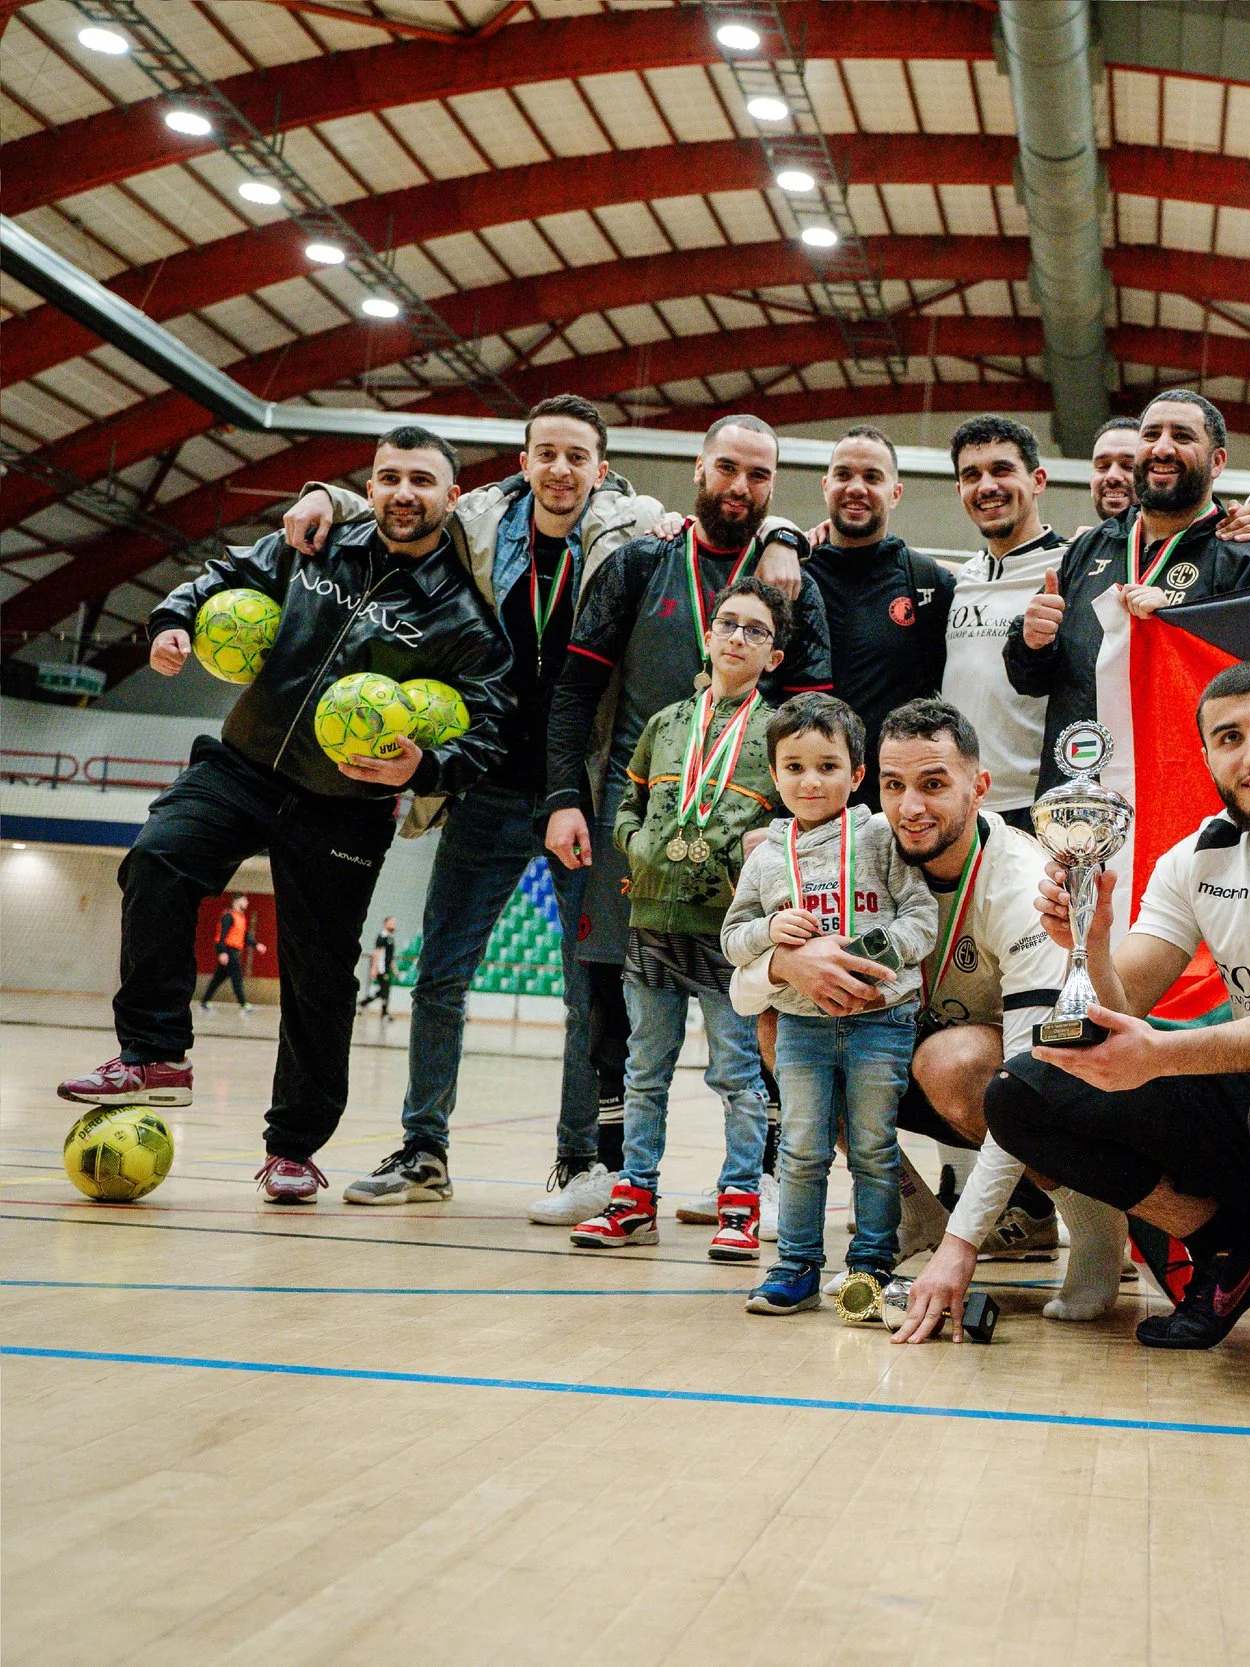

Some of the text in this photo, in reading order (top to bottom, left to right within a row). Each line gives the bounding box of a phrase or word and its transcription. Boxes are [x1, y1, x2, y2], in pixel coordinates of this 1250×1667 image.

[289, 568, 423, 648] NOWRUZ
[379, 741, 401, 755] TAR
[803, 881, 839, 893] Since
[854, 891, 879, 913] CO
